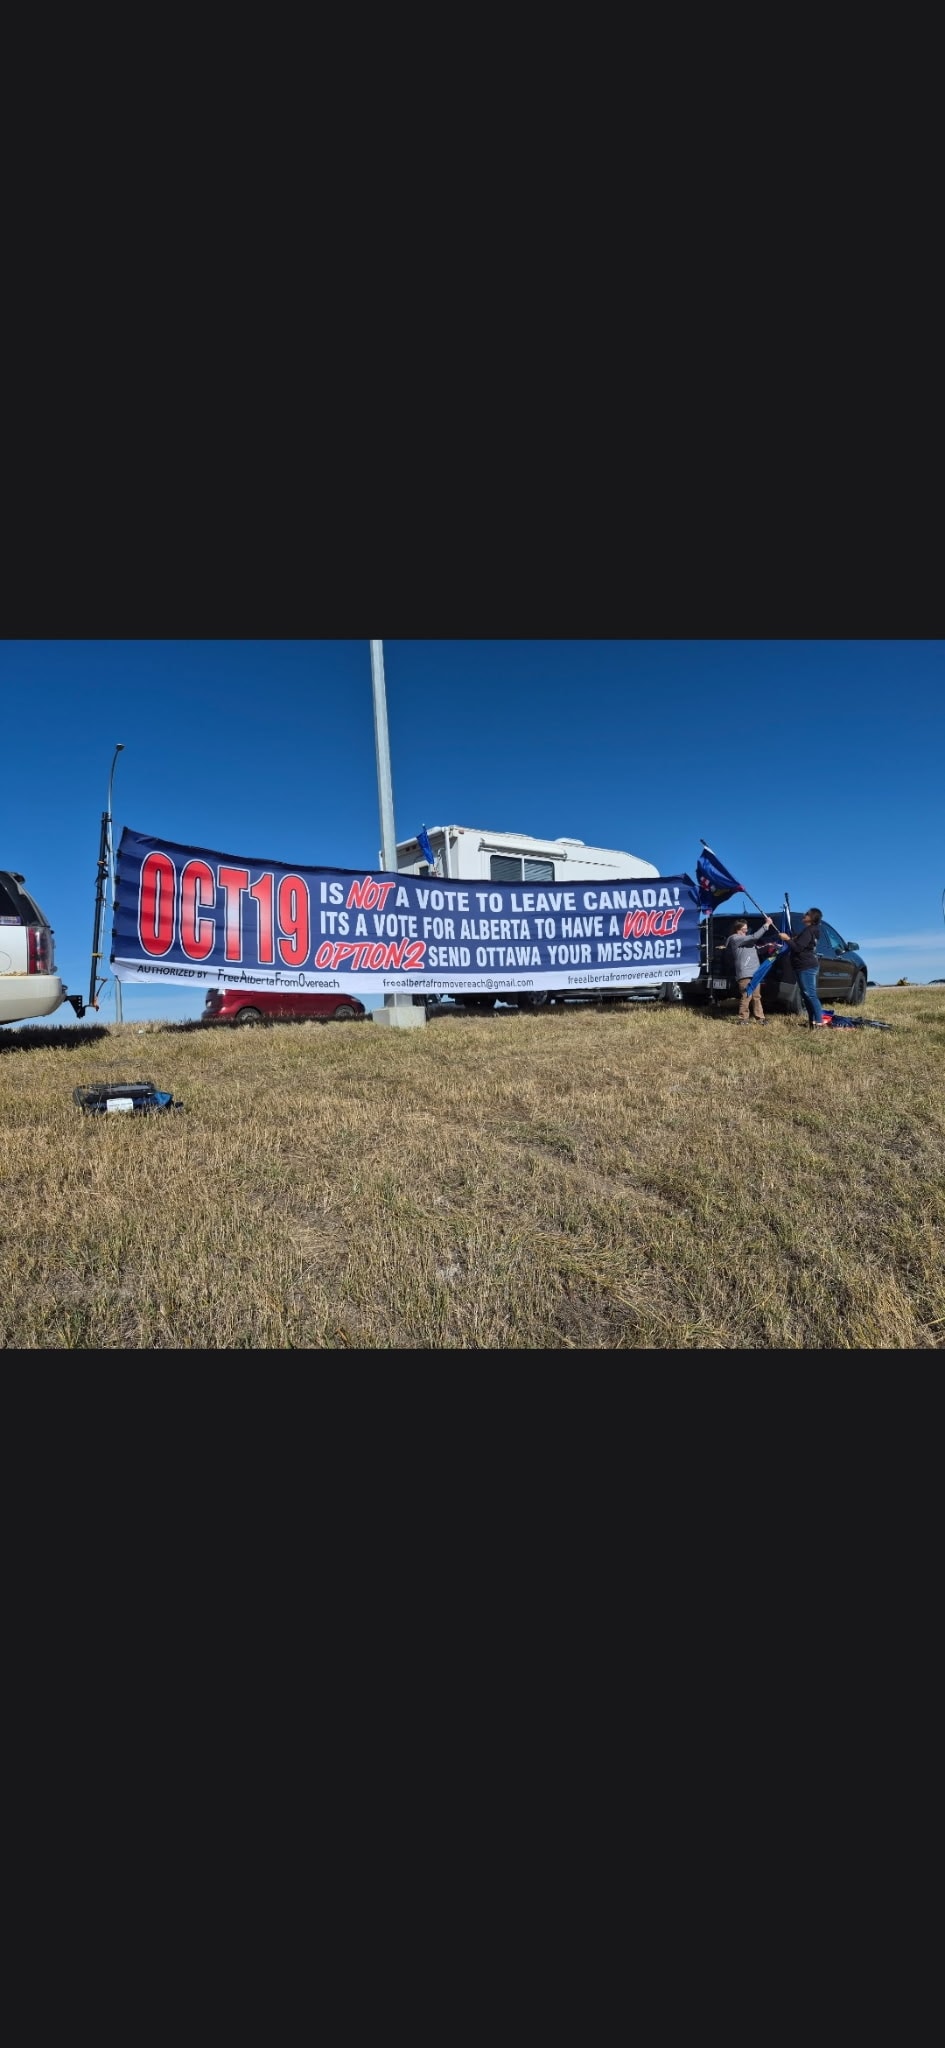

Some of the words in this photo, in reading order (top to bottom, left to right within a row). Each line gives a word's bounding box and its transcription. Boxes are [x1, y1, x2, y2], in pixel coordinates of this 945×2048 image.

[138, 851, 311, 967] OCT19
[320, 882, 344, 905] IS
[345, 875, 396, 911] NOT
[395, 886, 410, 908] A
[415, 888, 470, 912] VOTE
[475, 893, 503, 913] TO
[511, 892, 576, 912] LEAVE
[583, 887, 680, 910] CANADA!
[320, 911, 349, 935] ITS
[355, 913, 368, 937] A
[373, 914, 418, 938] VOTE
[423, 917, 455, 940] FOR
[460, 919, 530, 940] ALBERTA
[534, 918, 556, 940] TO
[561, 916, 604, 938] HAVE
[609, 915, 620, 937] A
[623, 907, 684, 939] VOICE!
[314, 937, 427, 971] OPTION2
[428, 945, 471, 967] SEND
[476, 946, 542, 967] OTTAWA
[547, 943, 592, 966] YOUR
[597, 938, 682, 963] MESSAGE!
[137, 964, 195, 978] AUTHORIZED
[197, 970, 208, 979] BY
[217, 969, 340, 989] FreeAlbertaFromOvereach
[383, 978, 534, 989] freealbertafromovereach@gmail.com
[567, 969, 681, 985] freealbertafromovereachcom
